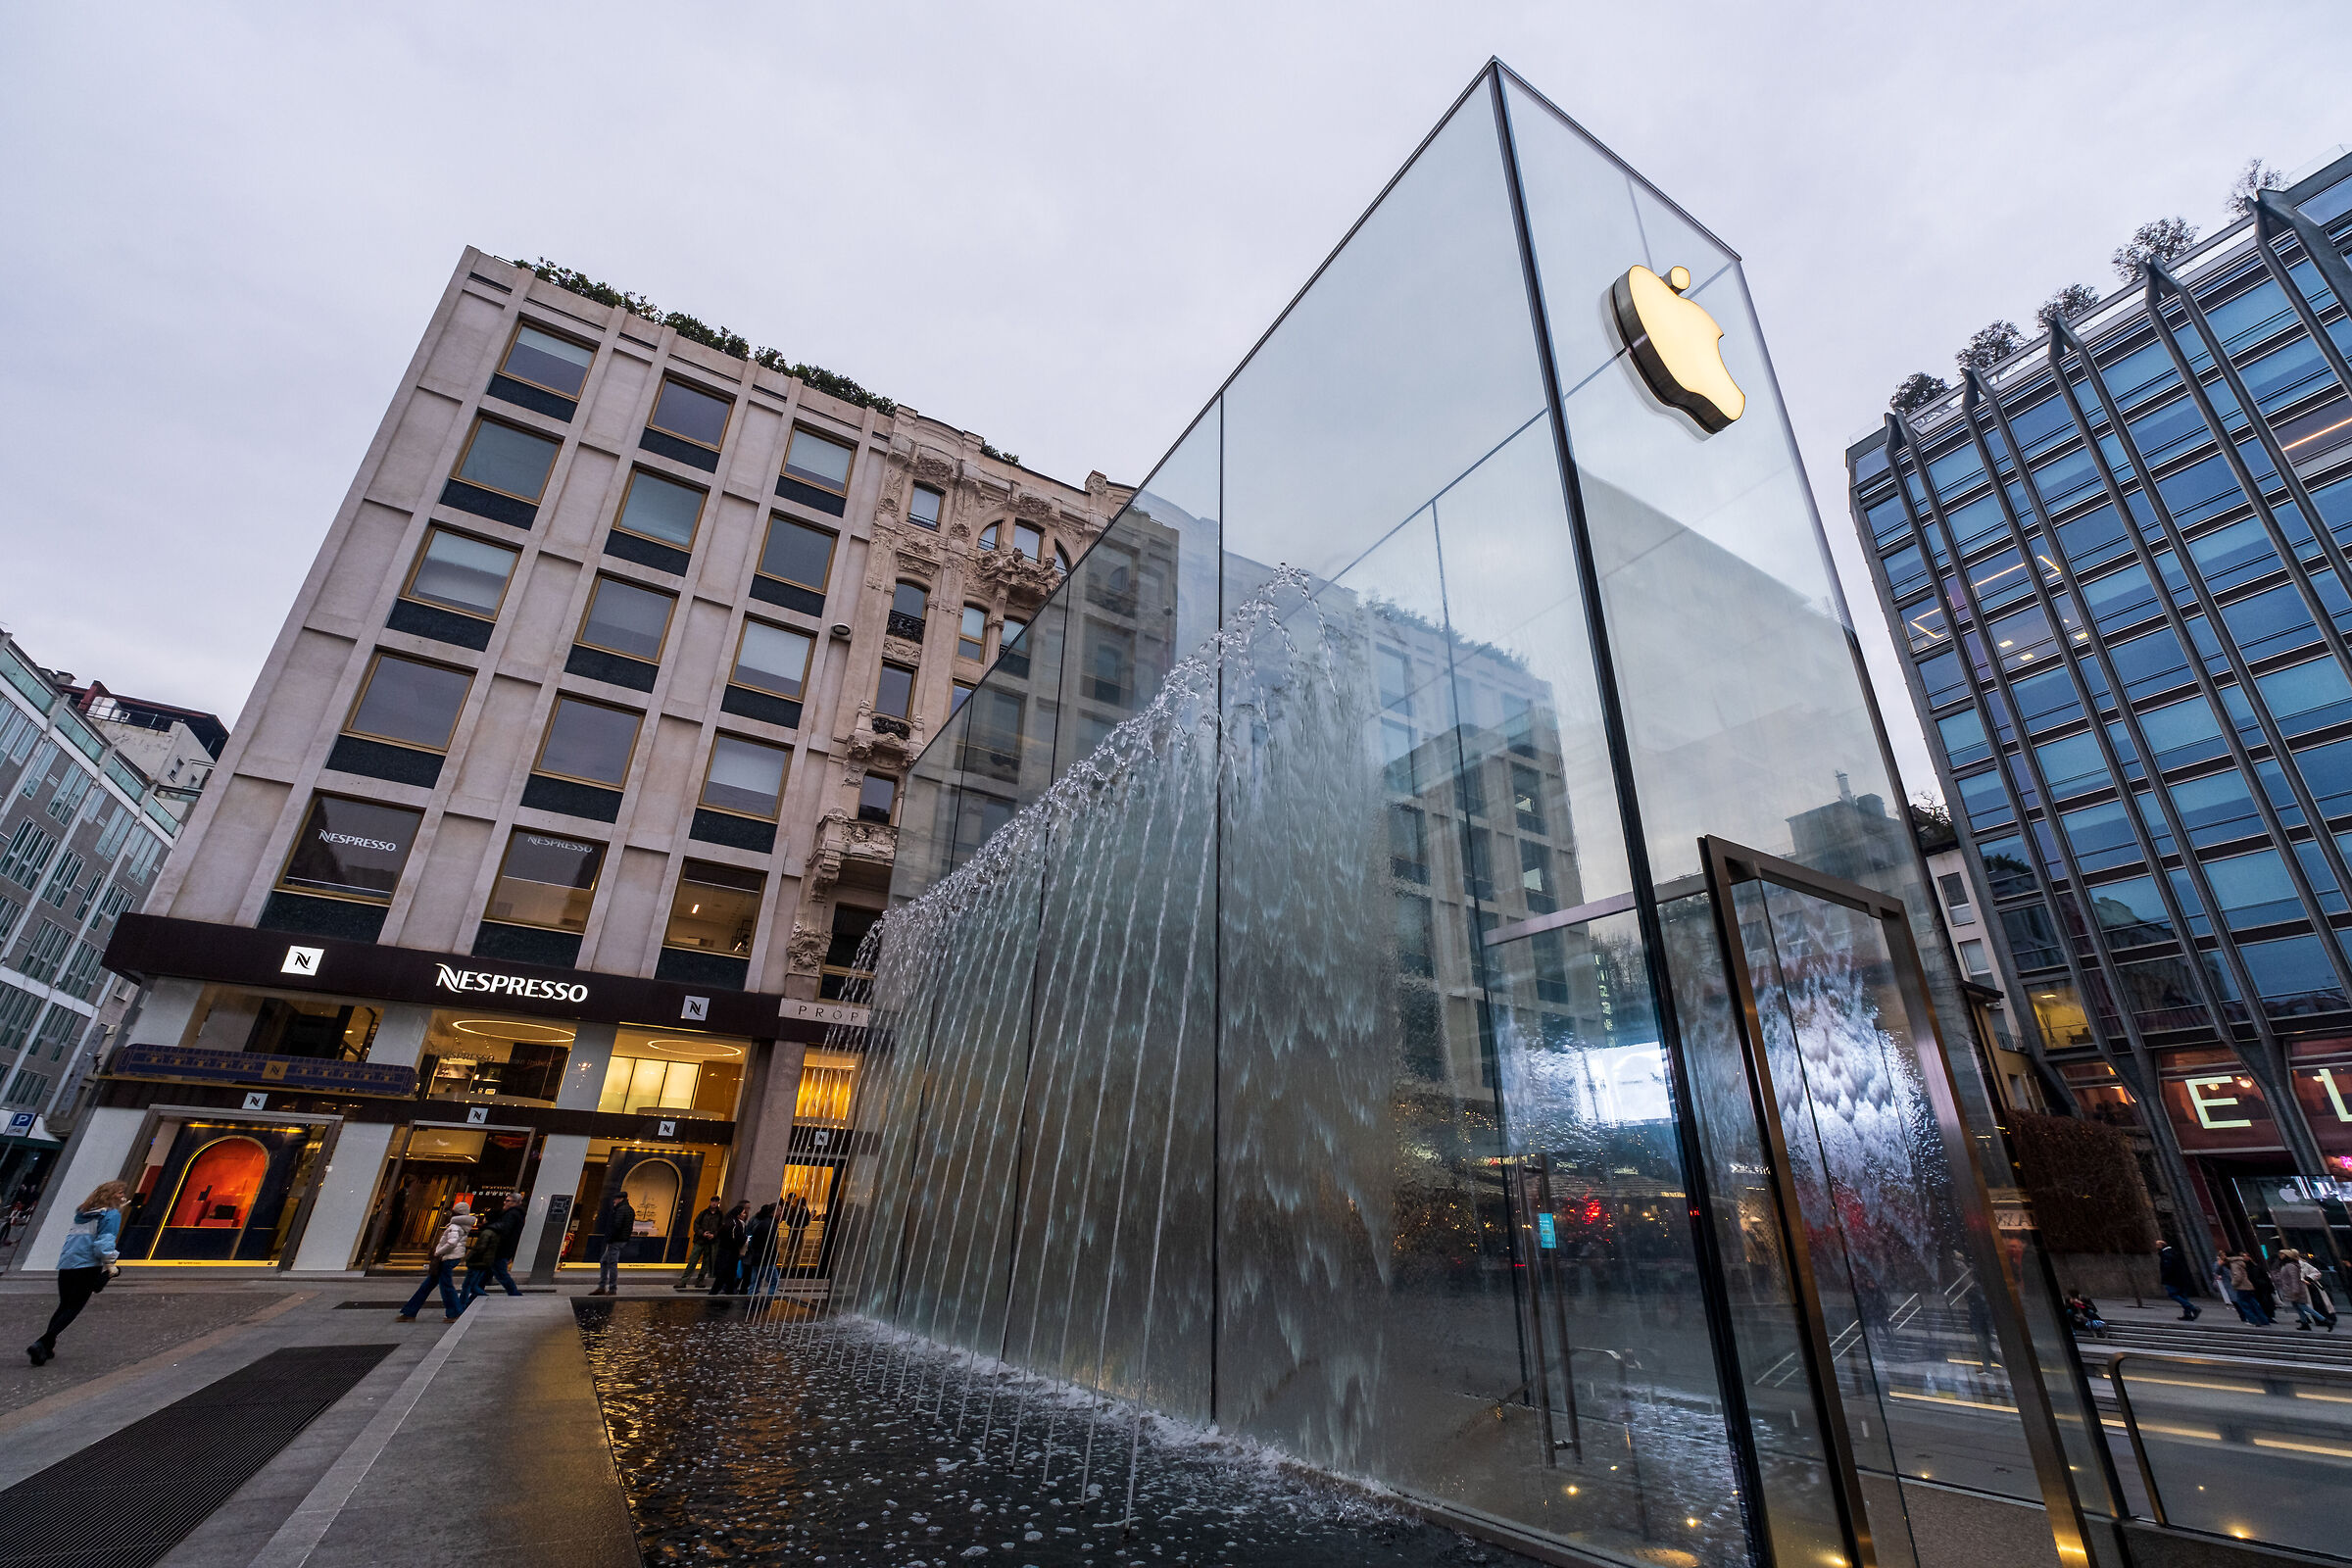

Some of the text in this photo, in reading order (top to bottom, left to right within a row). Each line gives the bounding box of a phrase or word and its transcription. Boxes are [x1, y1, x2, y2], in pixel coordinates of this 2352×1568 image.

[318, 828, 396, 852] NESPRESSO
[435, 962, 589, 1003] NESPRESSO
[15, 1114, 29, 1125] P
